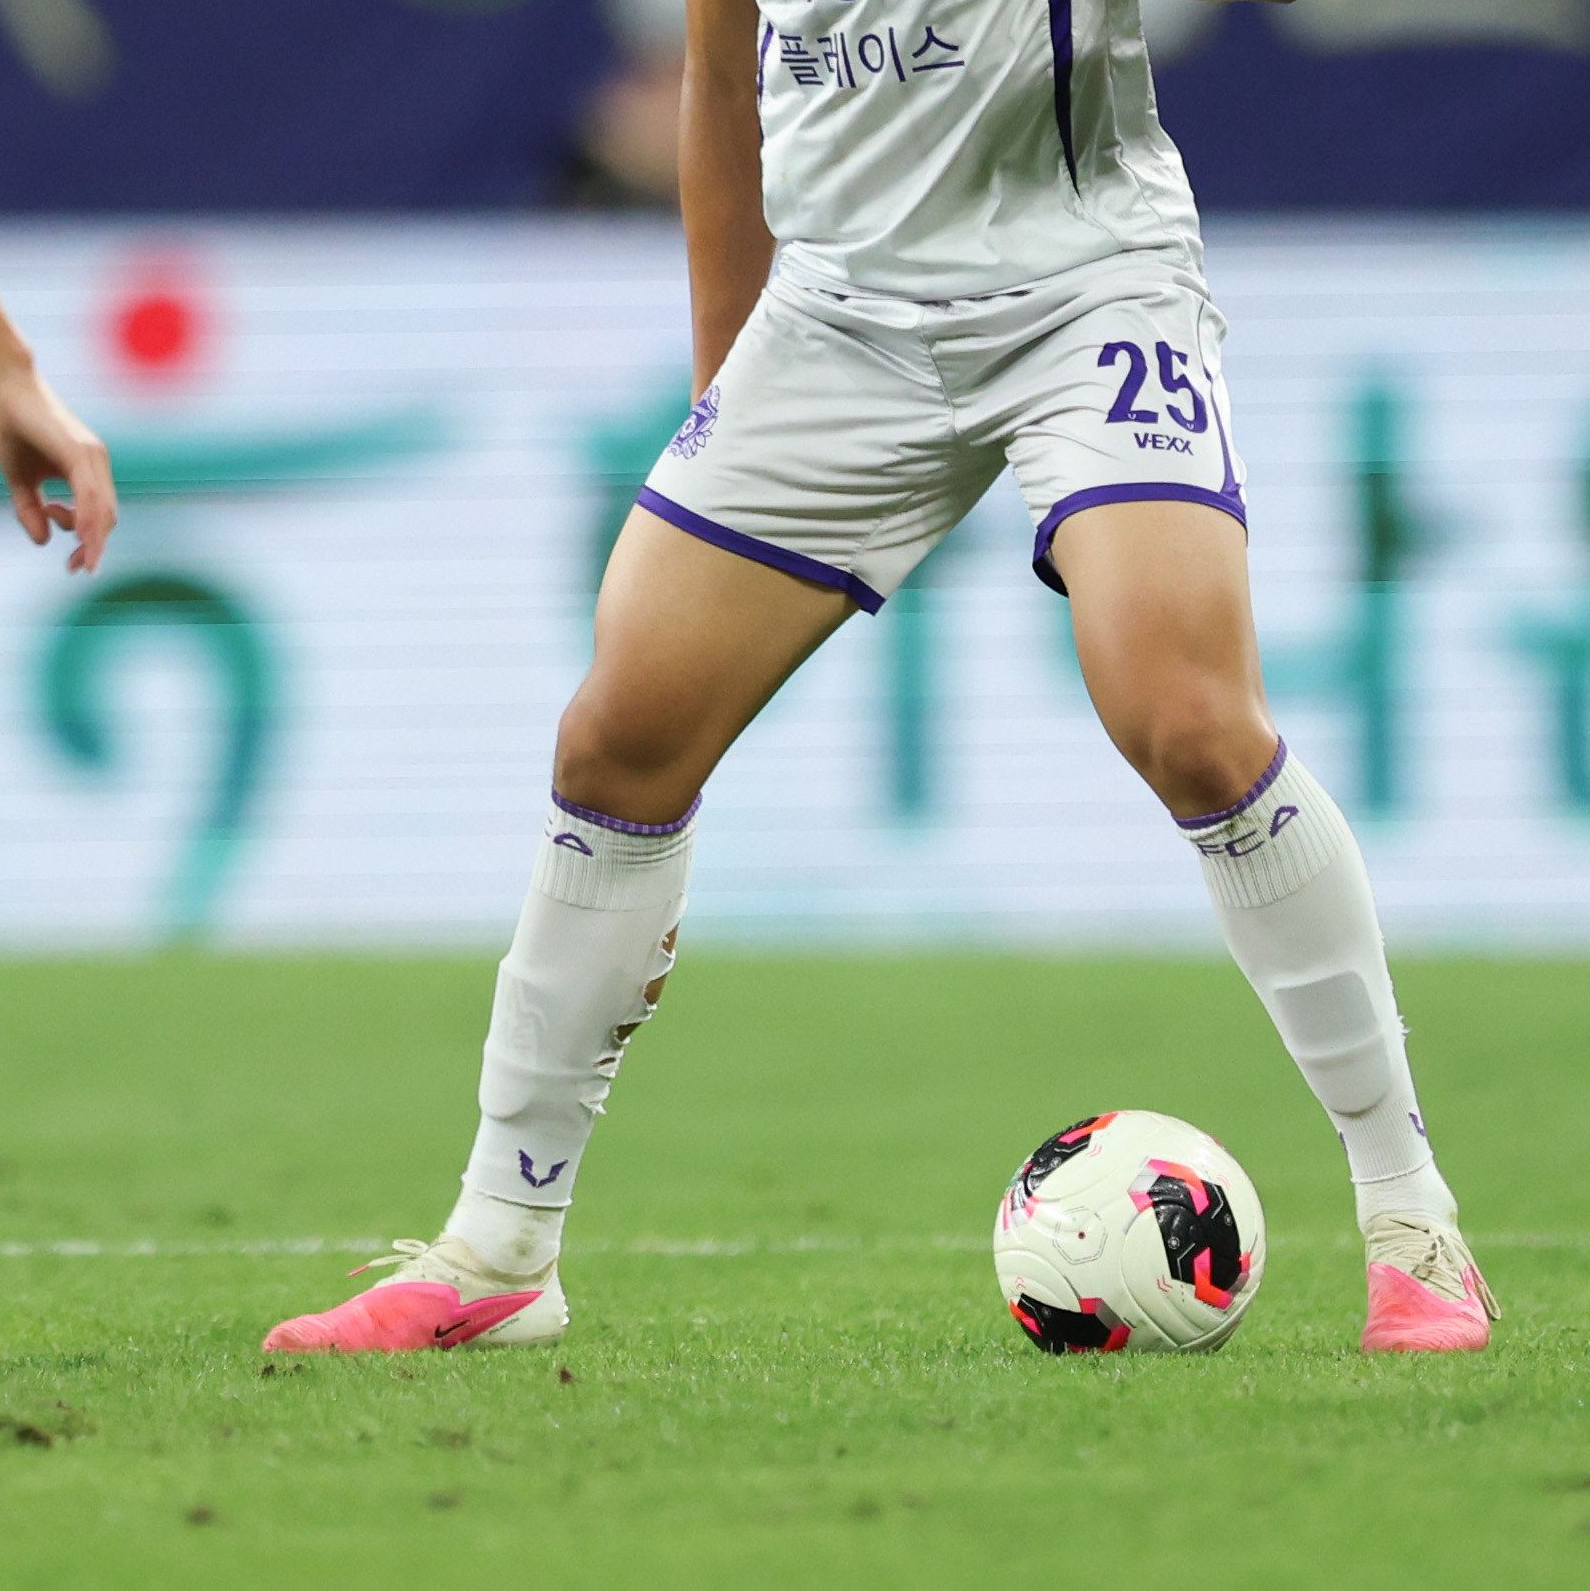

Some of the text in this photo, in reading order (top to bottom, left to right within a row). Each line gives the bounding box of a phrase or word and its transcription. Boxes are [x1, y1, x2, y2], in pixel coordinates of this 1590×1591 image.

[779, 26, 966, 89] 플레이스
[1097, 340, 1209, 434] 25
[1133, 432, 1195, 457] VEXX
